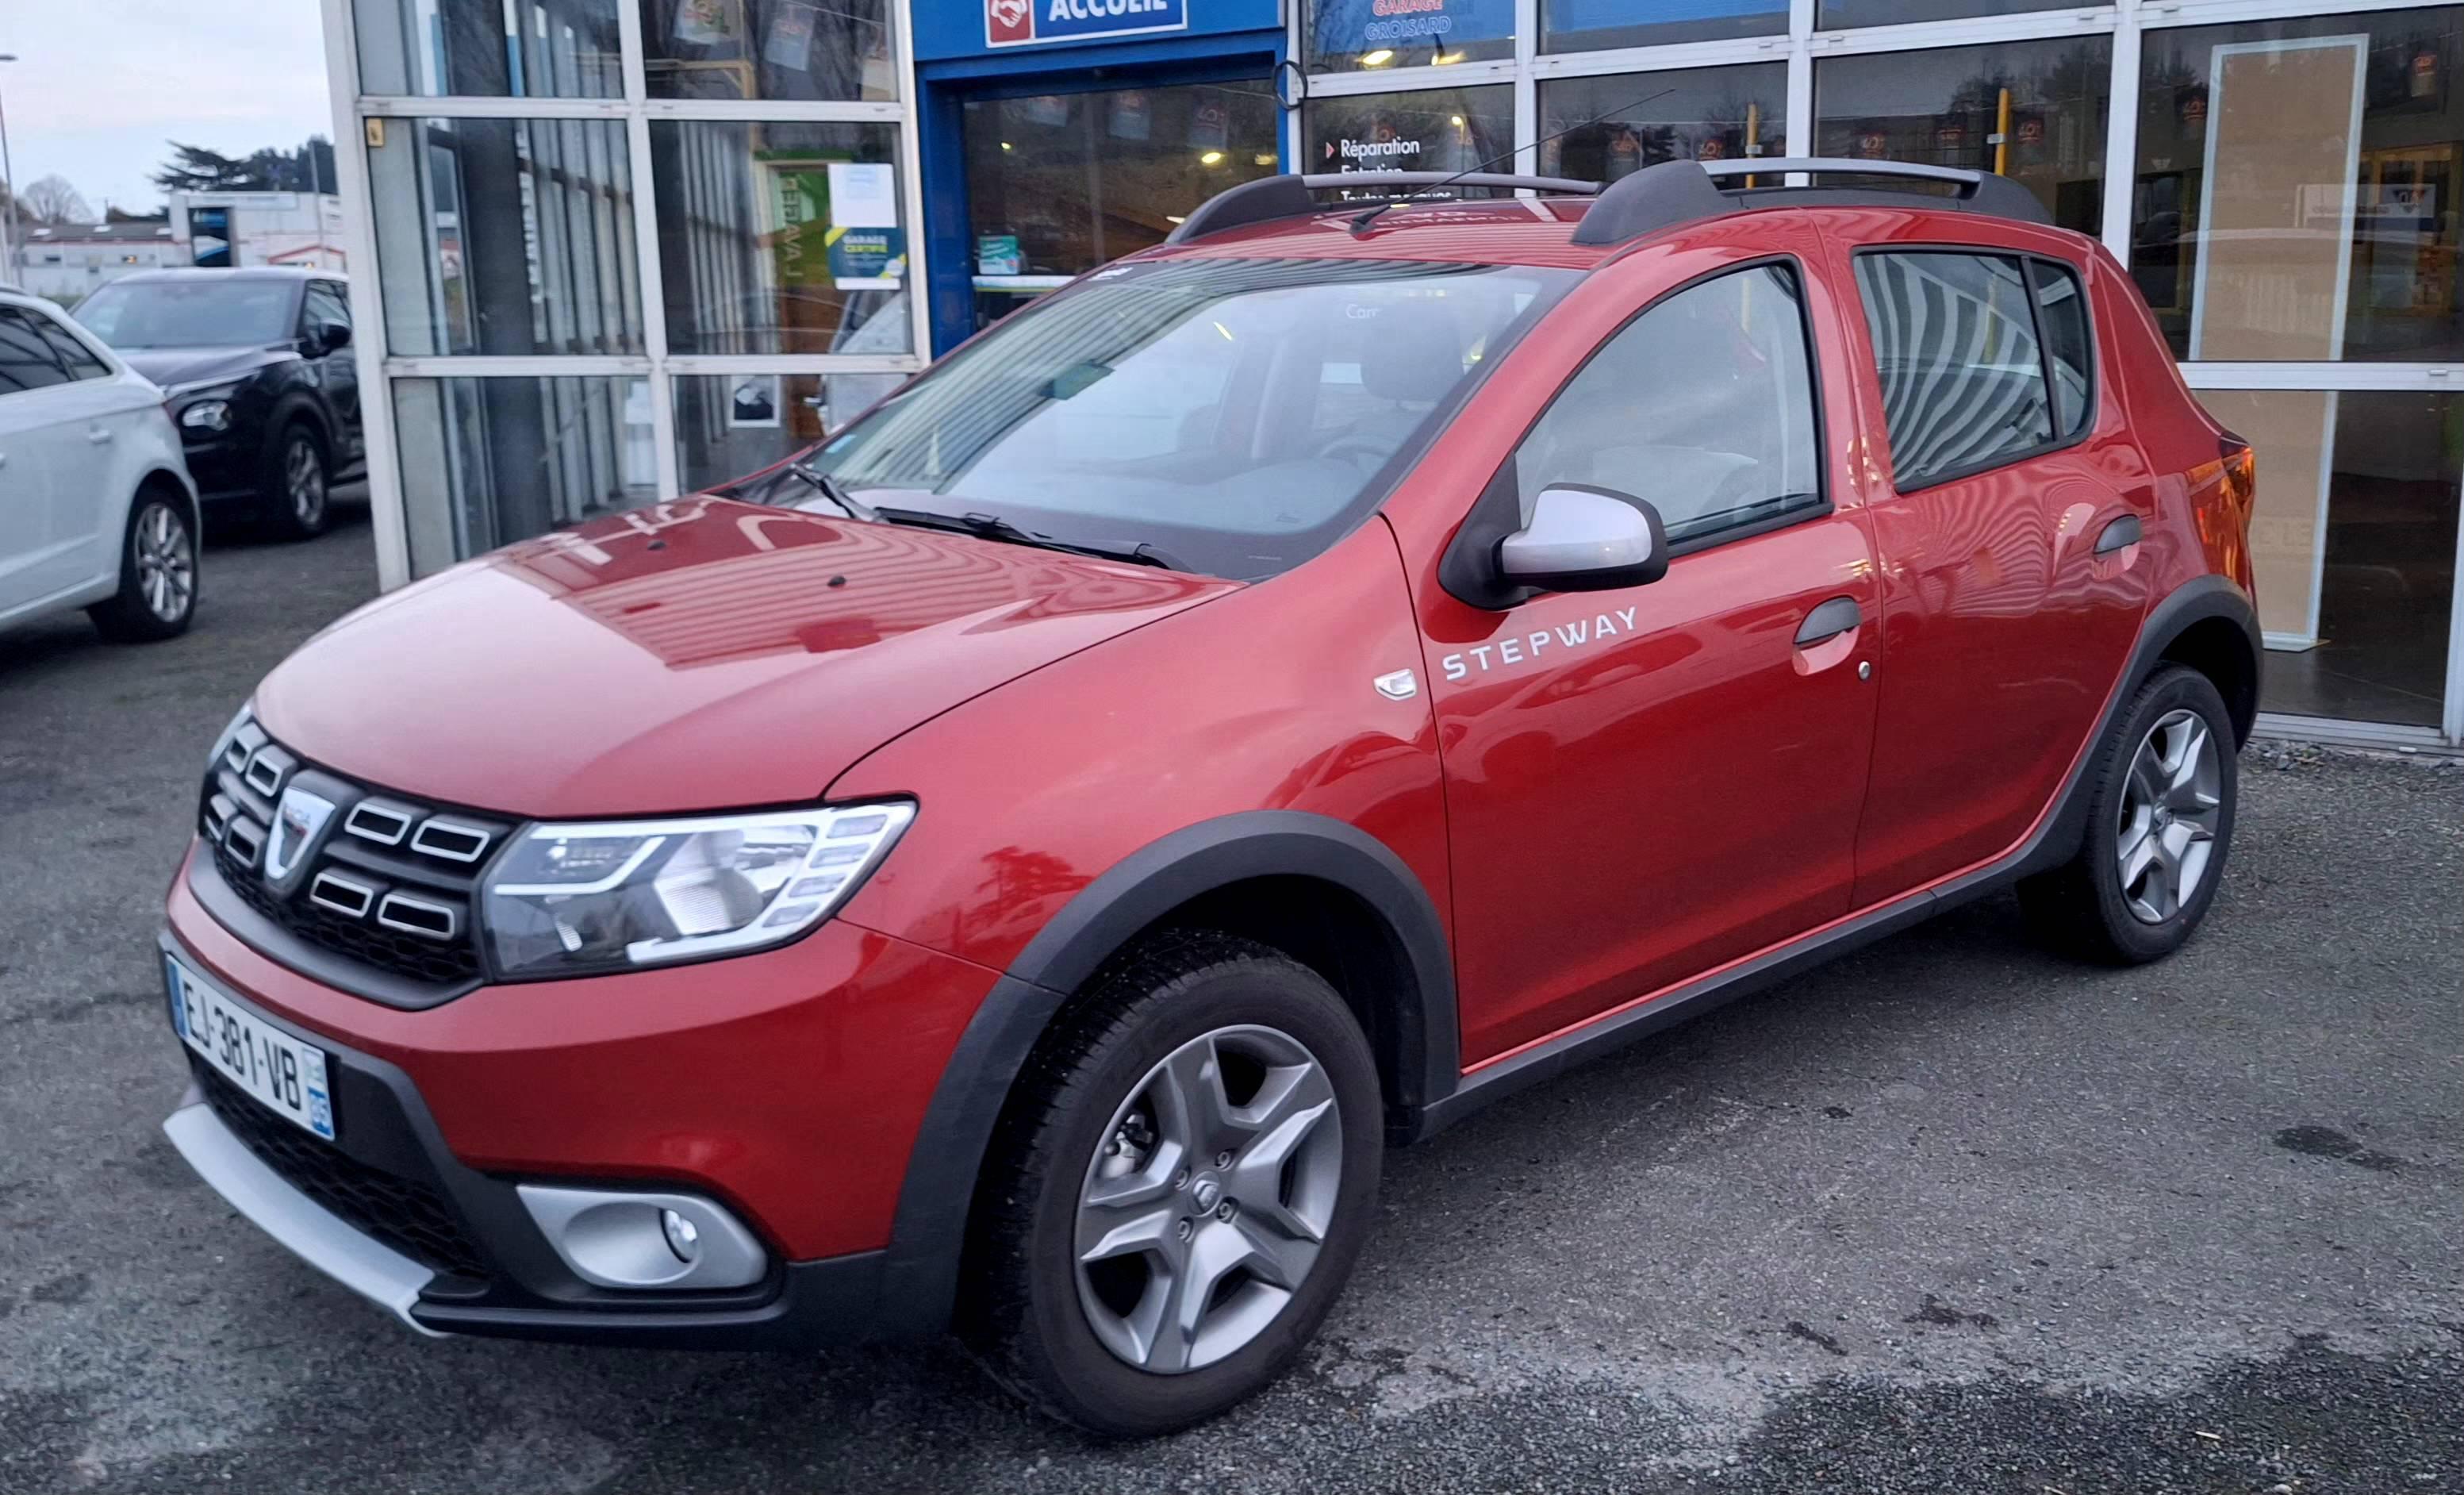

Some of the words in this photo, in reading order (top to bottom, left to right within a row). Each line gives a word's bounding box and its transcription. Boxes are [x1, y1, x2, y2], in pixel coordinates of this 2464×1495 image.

[1372, 0, 1443, 16] GARAGE
[1364, 16, 1453, 40] GROISARD
[1341, 136, 1420, 161] Réparation
[1442, 606, 1636, 681] STEPWAY
[183, 981, 301, 1112] EJ-381-VB
